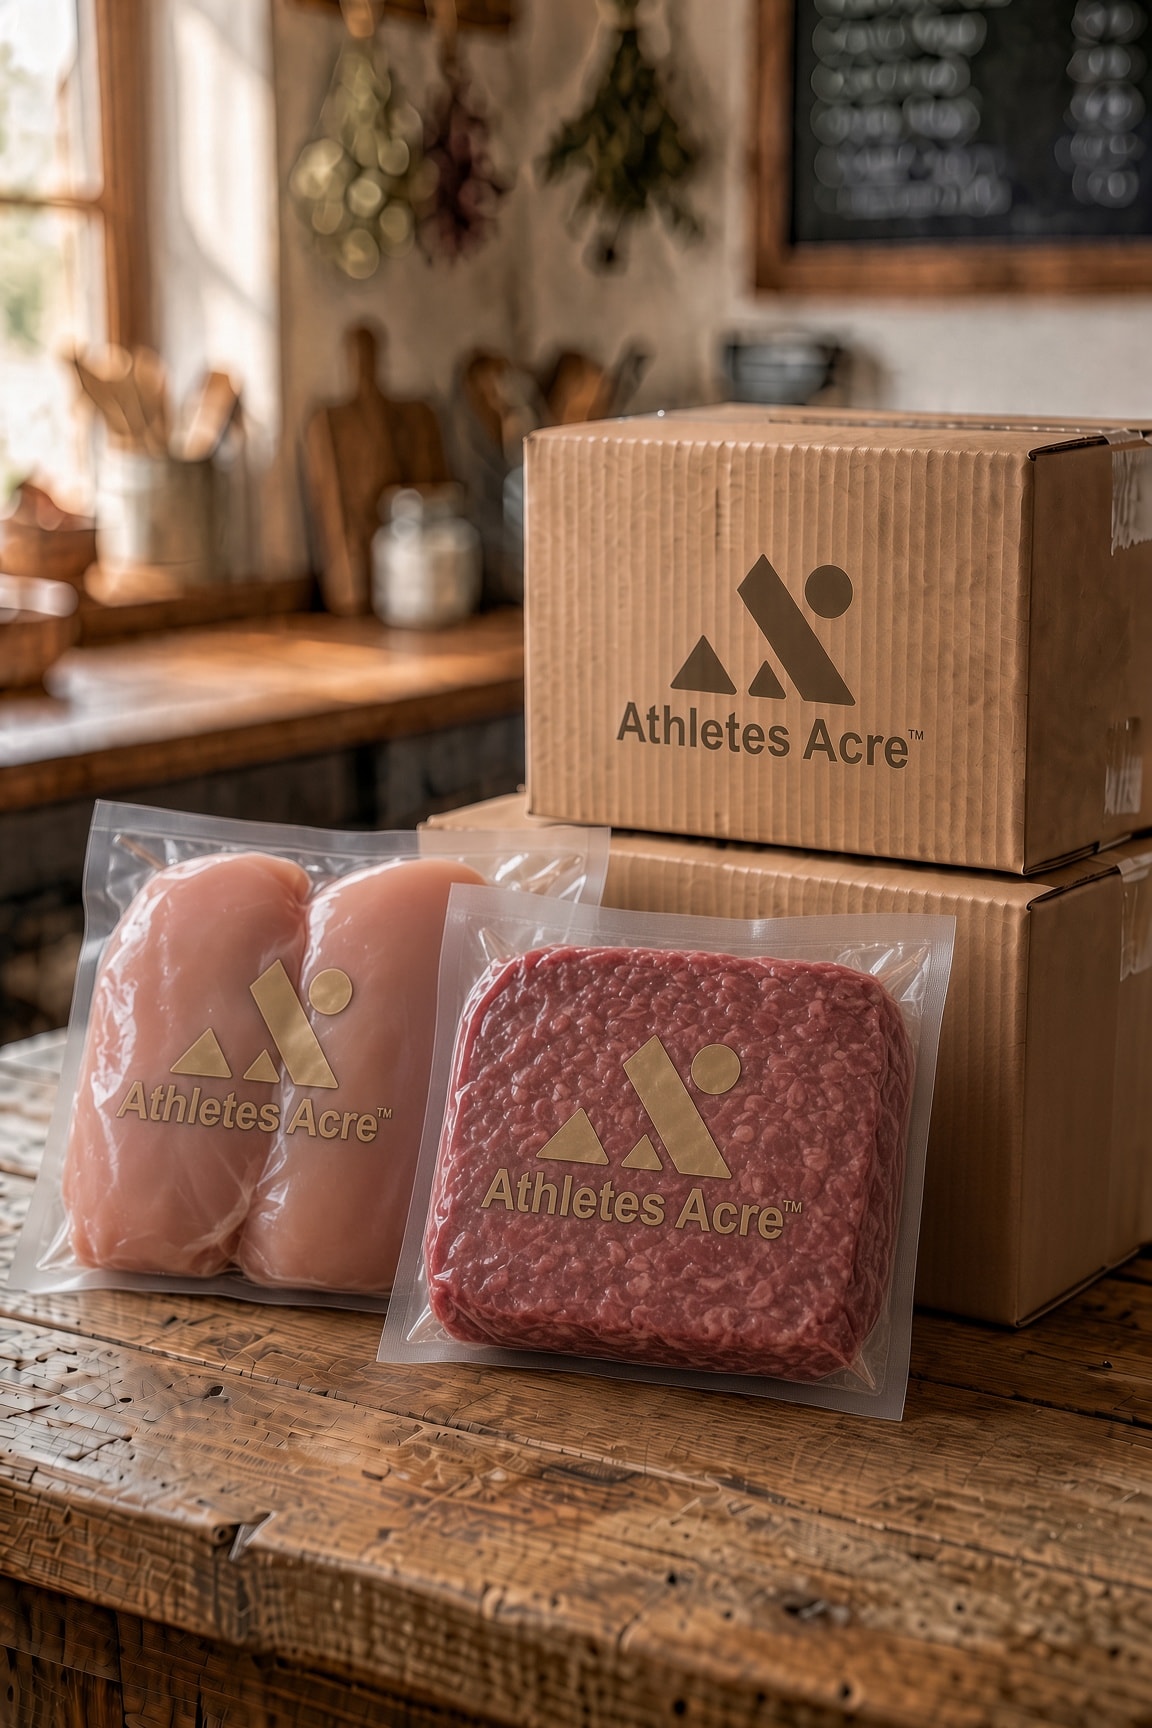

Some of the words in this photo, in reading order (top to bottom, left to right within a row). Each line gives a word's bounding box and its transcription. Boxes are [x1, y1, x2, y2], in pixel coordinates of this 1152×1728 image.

[616, 701, 791, 758] Athletes
[116, 1080, 281, 1132] Athletes
[481, 1168, 666, 1227] Athletes
